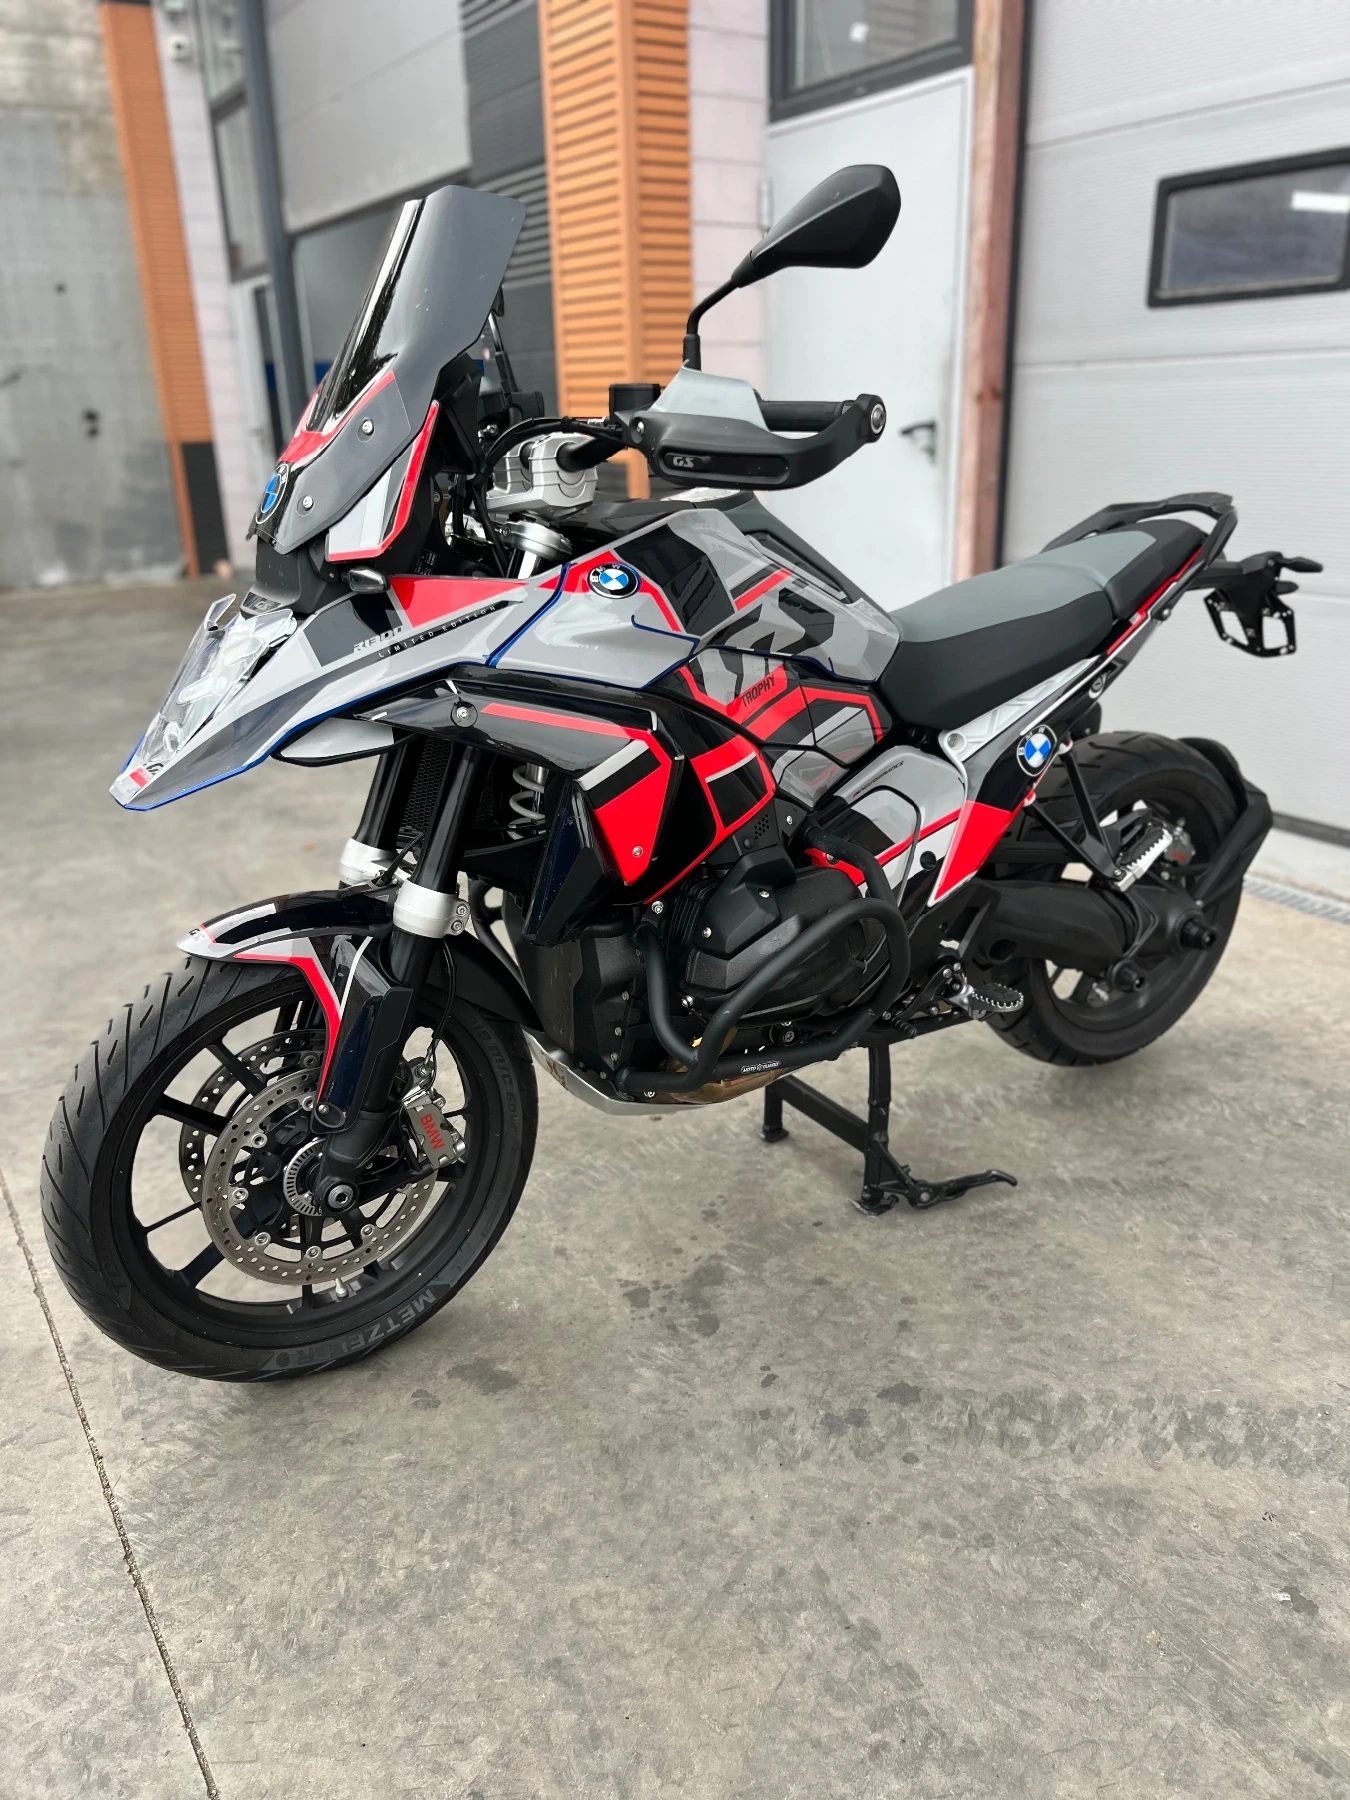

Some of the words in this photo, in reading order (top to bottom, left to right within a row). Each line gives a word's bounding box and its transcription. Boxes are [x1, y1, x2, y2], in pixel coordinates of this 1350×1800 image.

[672, 456, 695, 469] GS
[378, 631, 434, 658] LIMITED
[442, 606, 496, 632] EDITION
[740, 673, 775, 708] TROPHY
[420, 1112, 446, 1149] BMW
